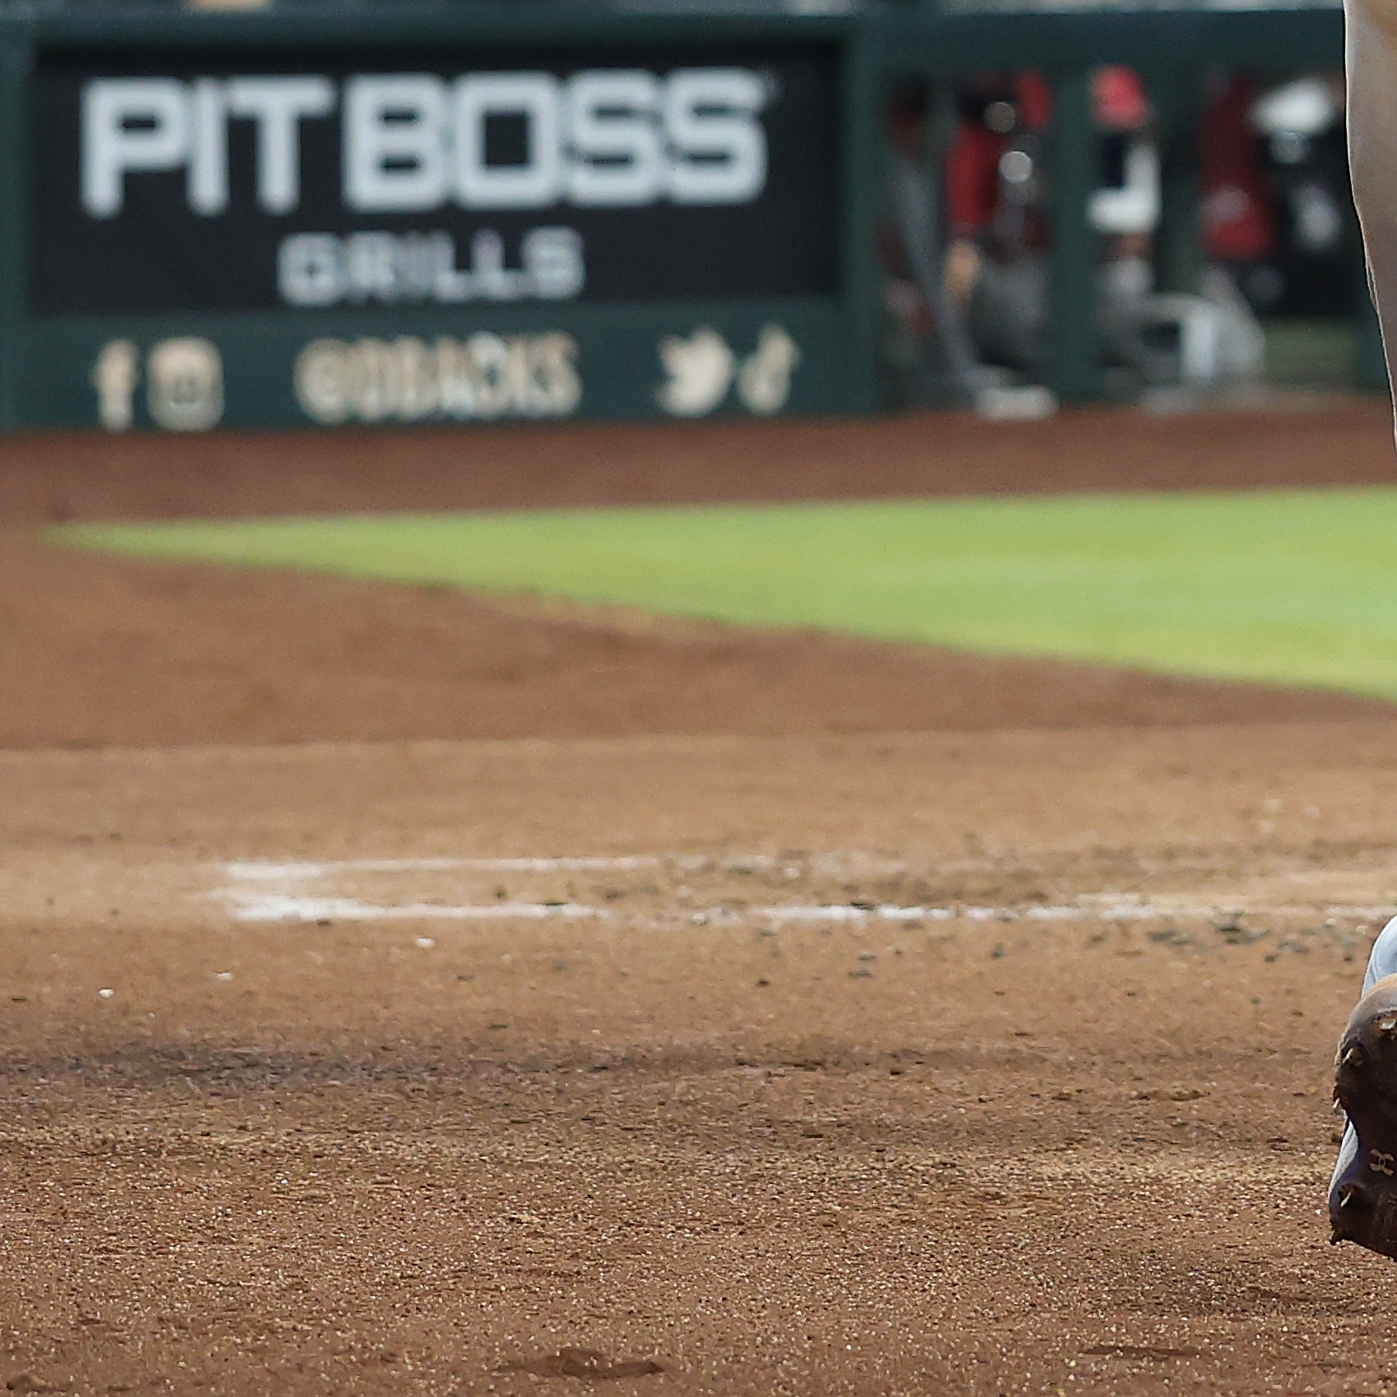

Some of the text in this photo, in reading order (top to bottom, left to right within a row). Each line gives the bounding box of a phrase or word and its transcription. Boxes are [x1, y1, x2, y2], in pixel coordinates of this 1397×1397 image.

[81, 68, 767, 217] PIT BOSS
[277, 225, 585, 307] GRILLS
